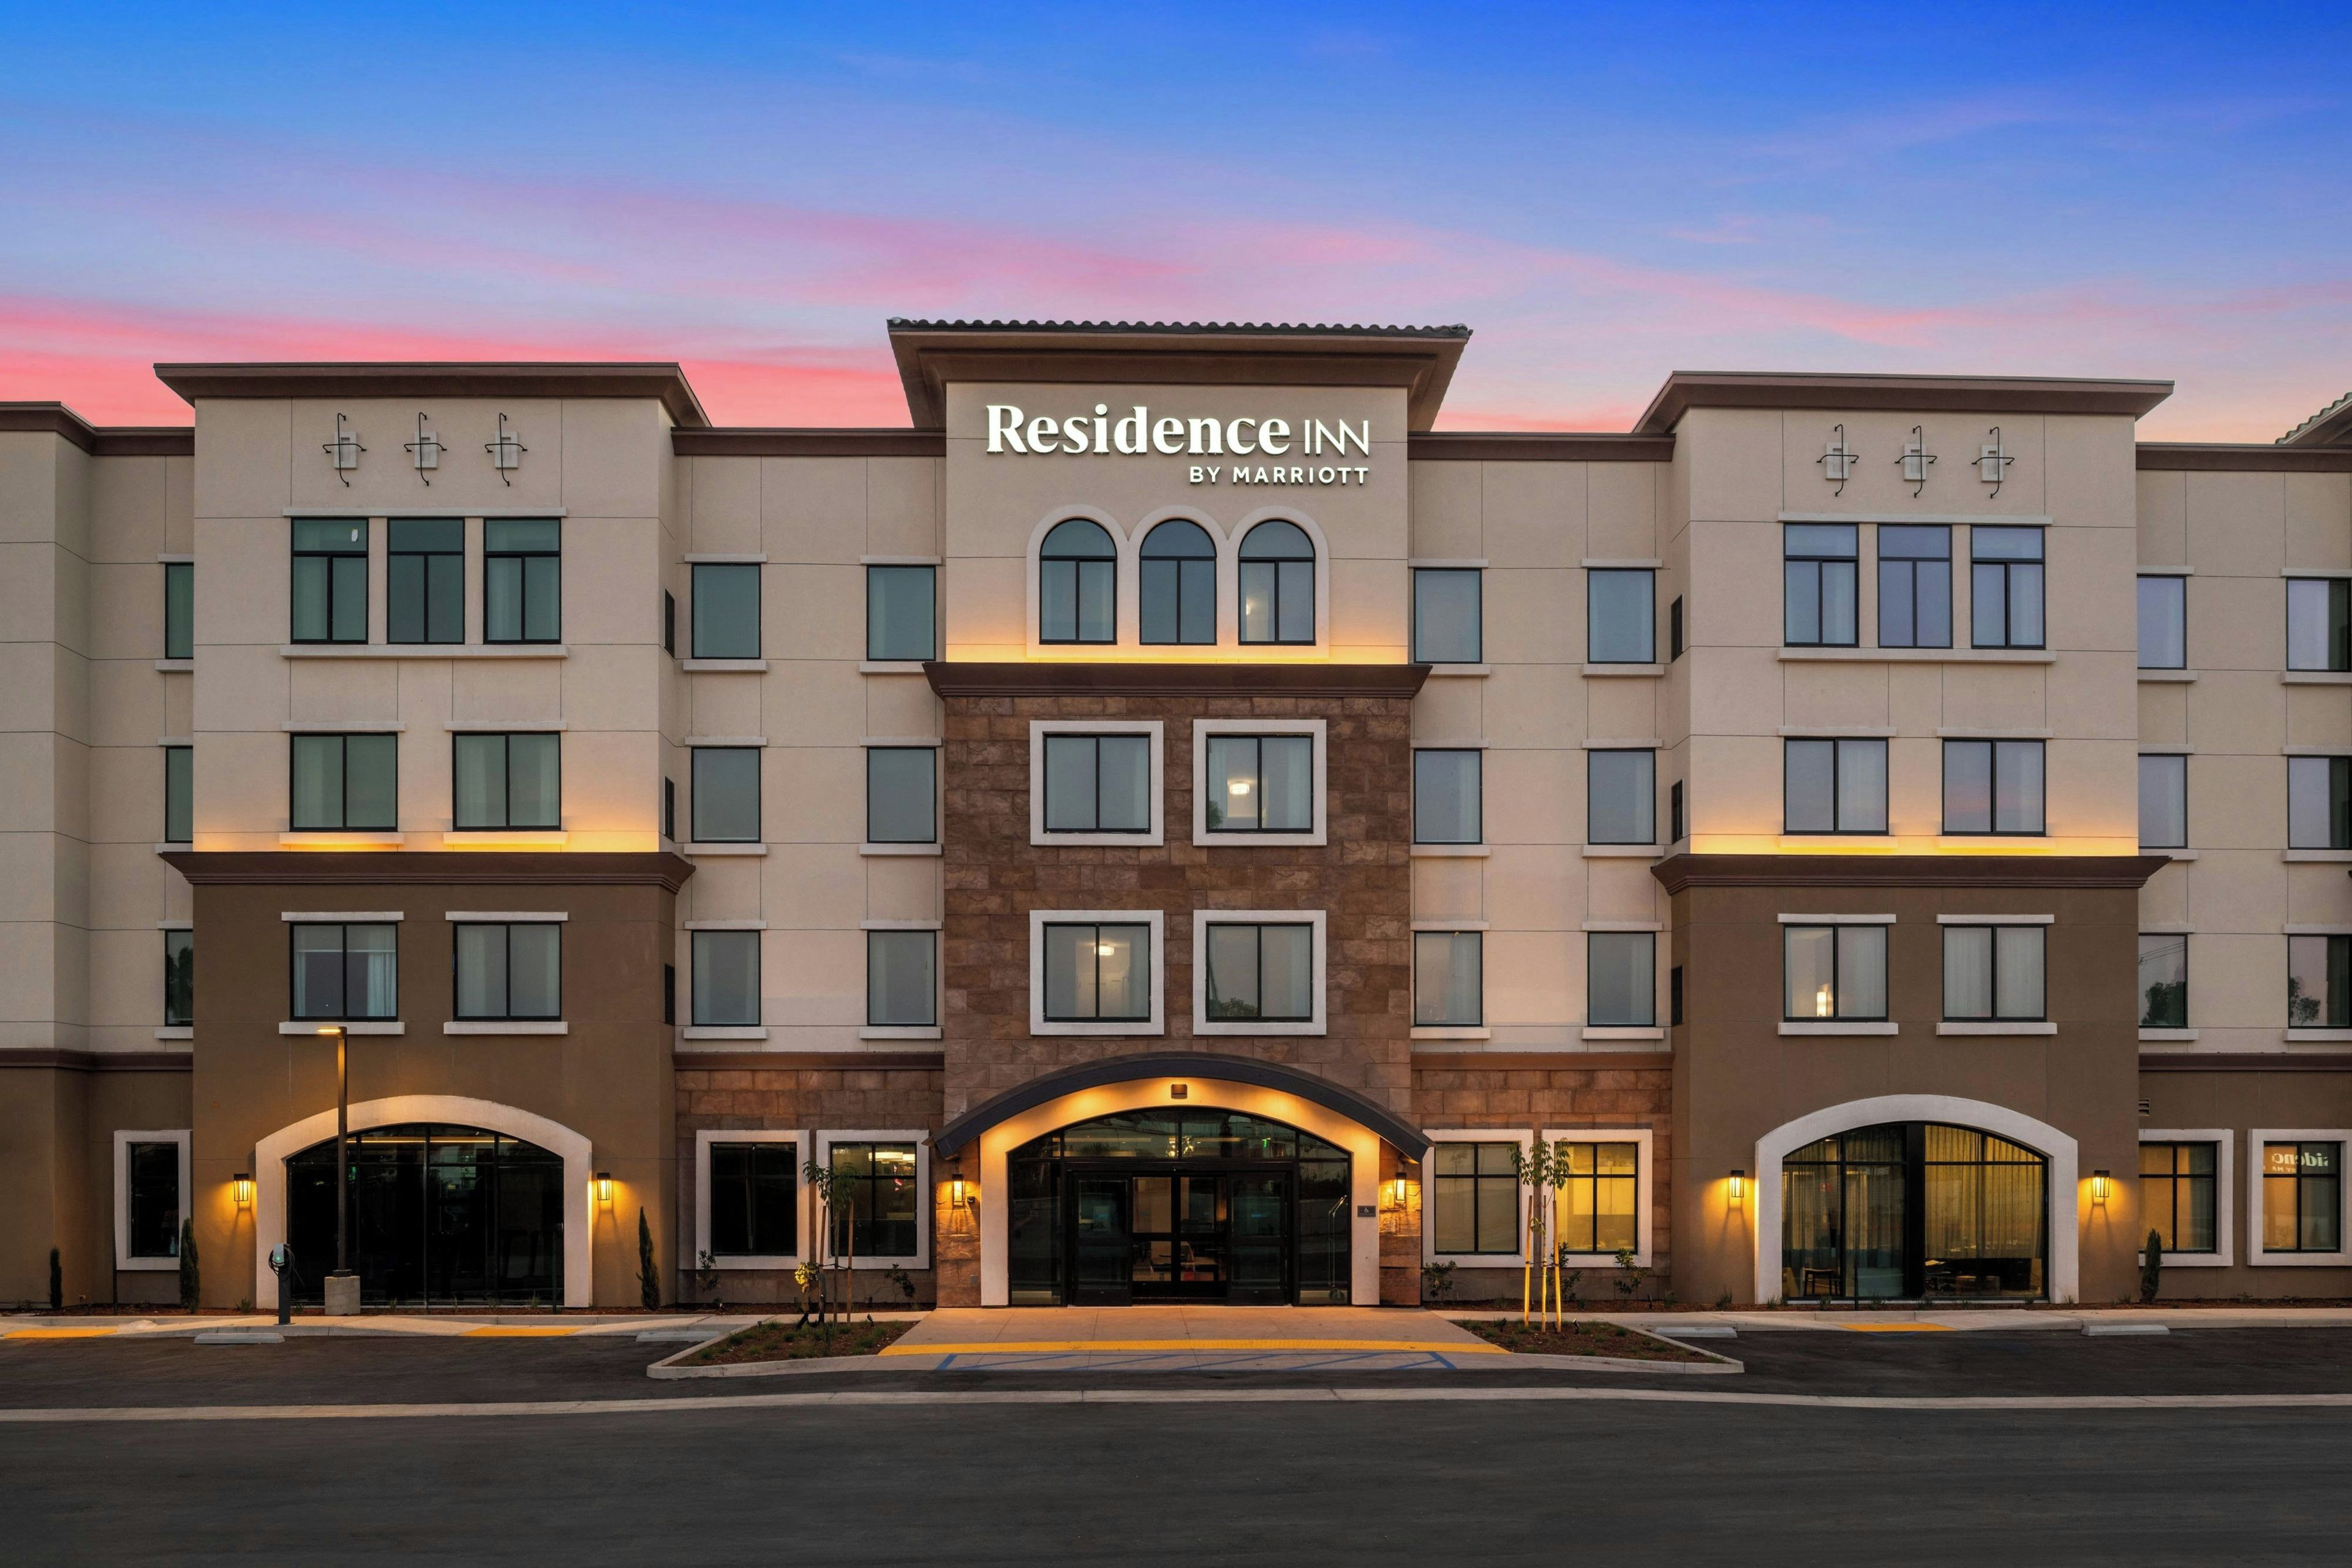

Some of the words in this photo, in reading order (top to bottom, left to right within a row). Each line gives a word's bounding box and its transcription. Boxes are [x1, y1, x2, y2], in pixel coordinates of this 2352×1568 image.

[986, 404, 1290, 454] Residence
[1305, 418, 1369, 457] INN
[1190, 466, 1221, 484] BY
[1233, 466, 1369, 484] MARRIOTT
